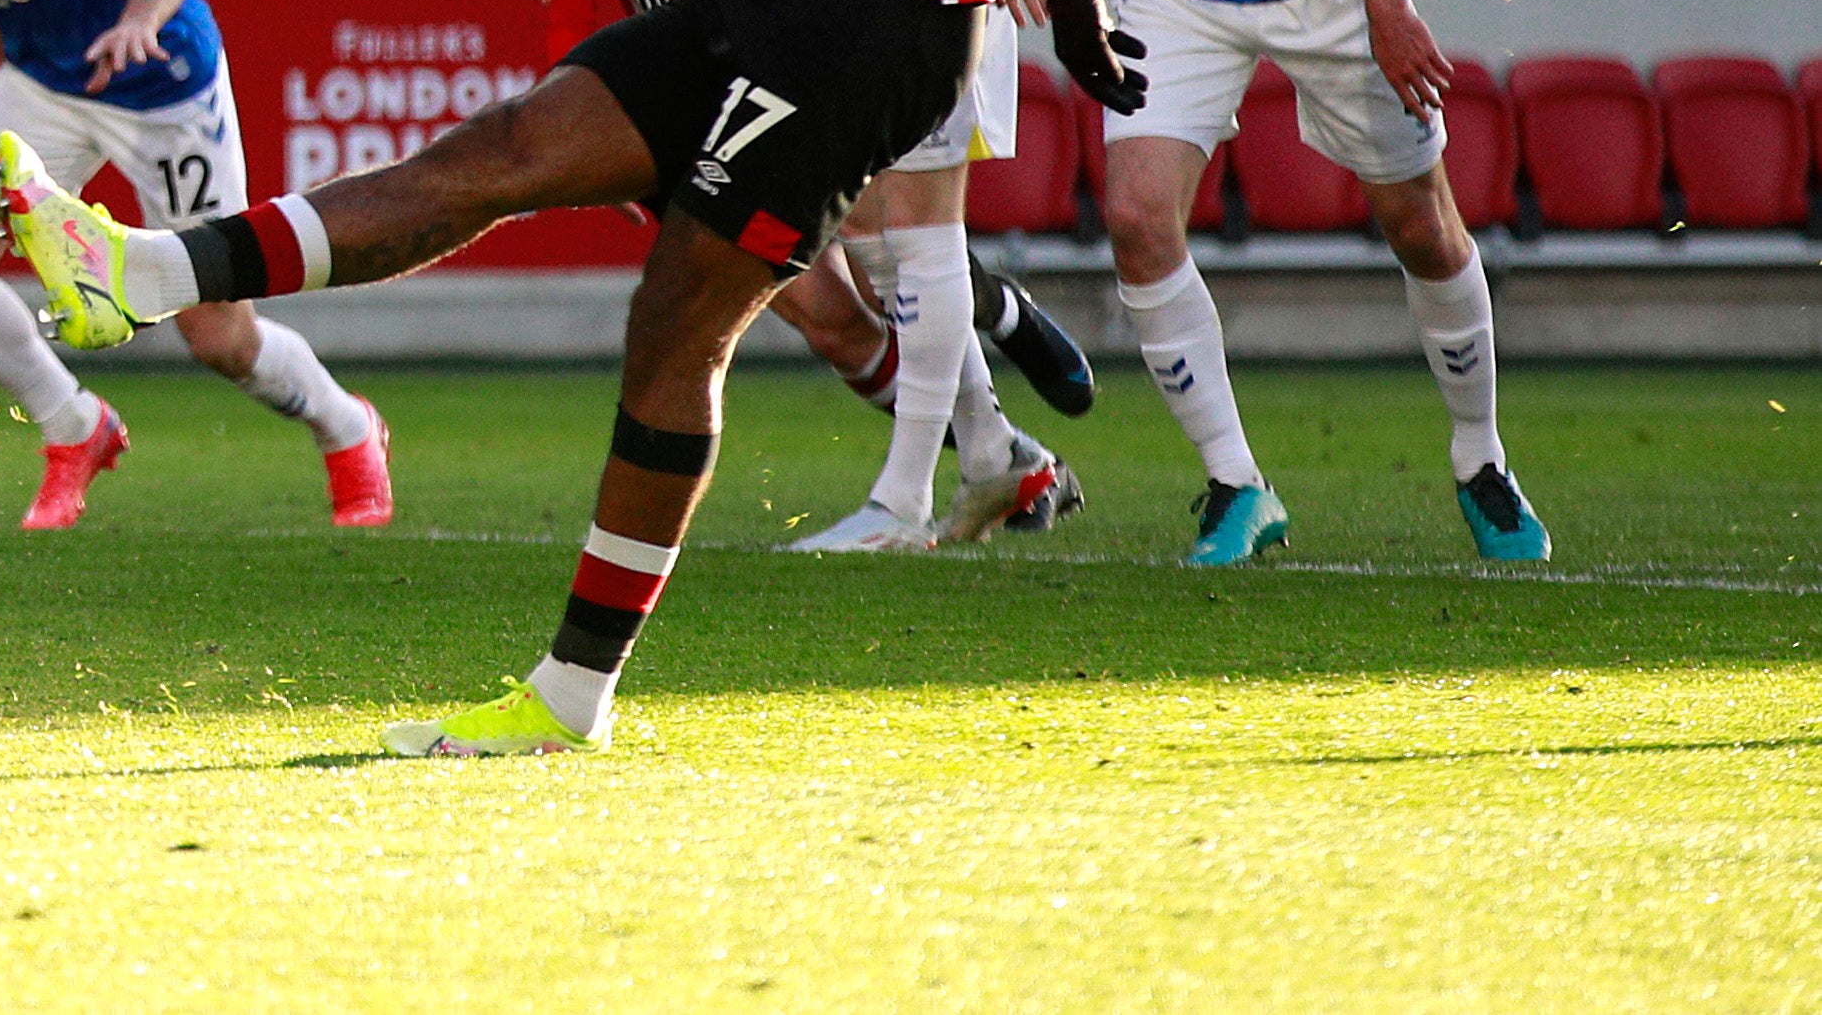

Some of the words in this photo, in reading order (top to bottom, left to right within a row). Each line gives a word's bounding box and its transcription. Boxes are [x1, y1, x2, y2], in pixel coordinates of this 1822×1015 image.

[282, 66, 537, 121] LONDON
[701, 76, 798, 163] 17
[157, 154, 220, 216] 12
